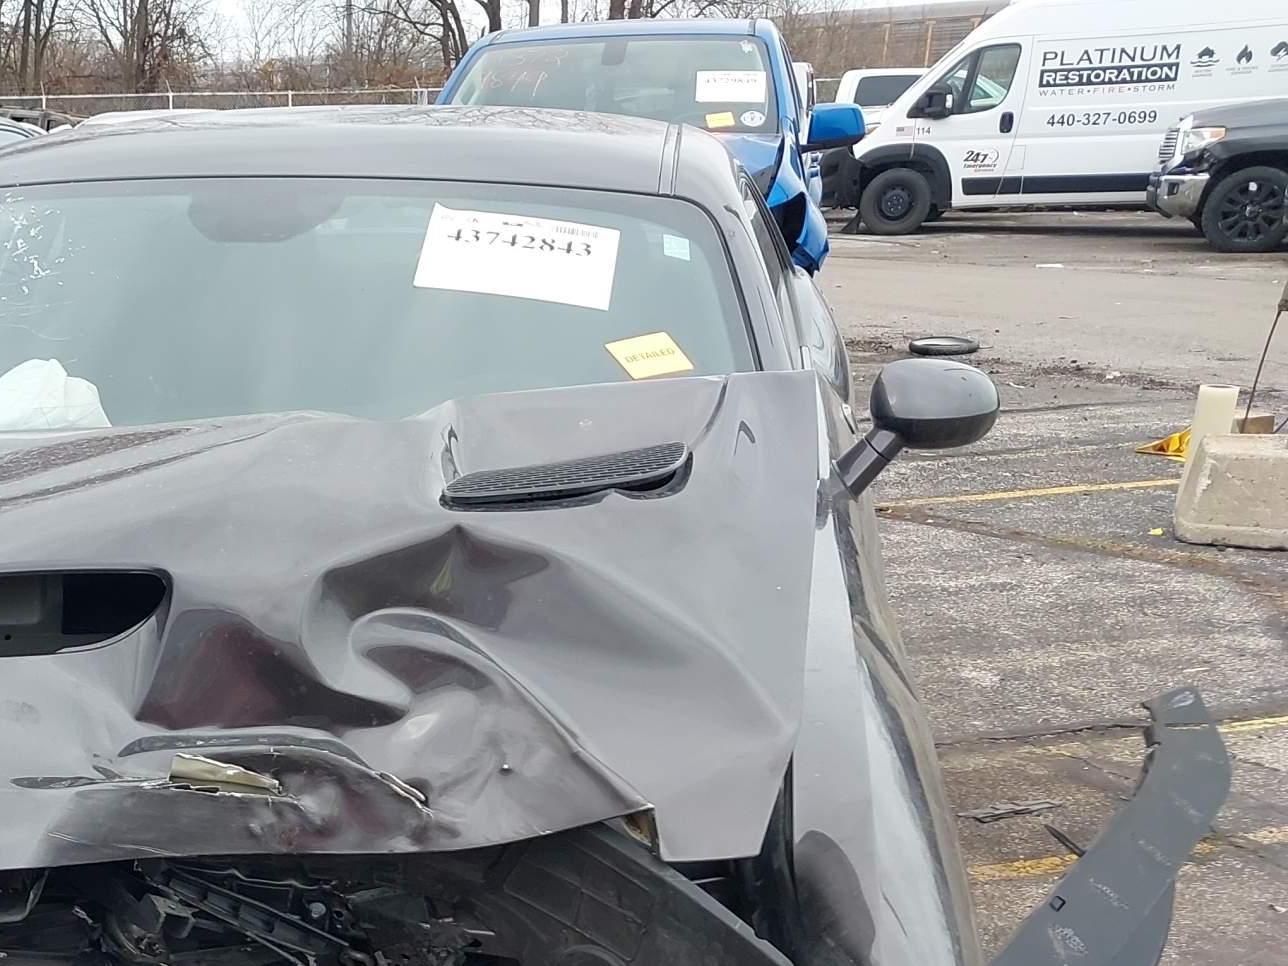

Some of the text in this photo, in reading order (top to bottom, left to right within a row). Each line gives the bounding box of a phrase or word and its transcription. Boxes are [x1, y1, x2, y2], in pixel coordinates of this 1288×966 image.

[1041, 43, 1182, 67] PLATINUM
[1042, 65, 1176, 85] RESTORATION
[1046, 110, 1158, 127] 440-327-0699
[916, 126, 931, 135] 114
[447, 228, 592, 257] 43742843
[624, 347, 675, 363] DETAILED
